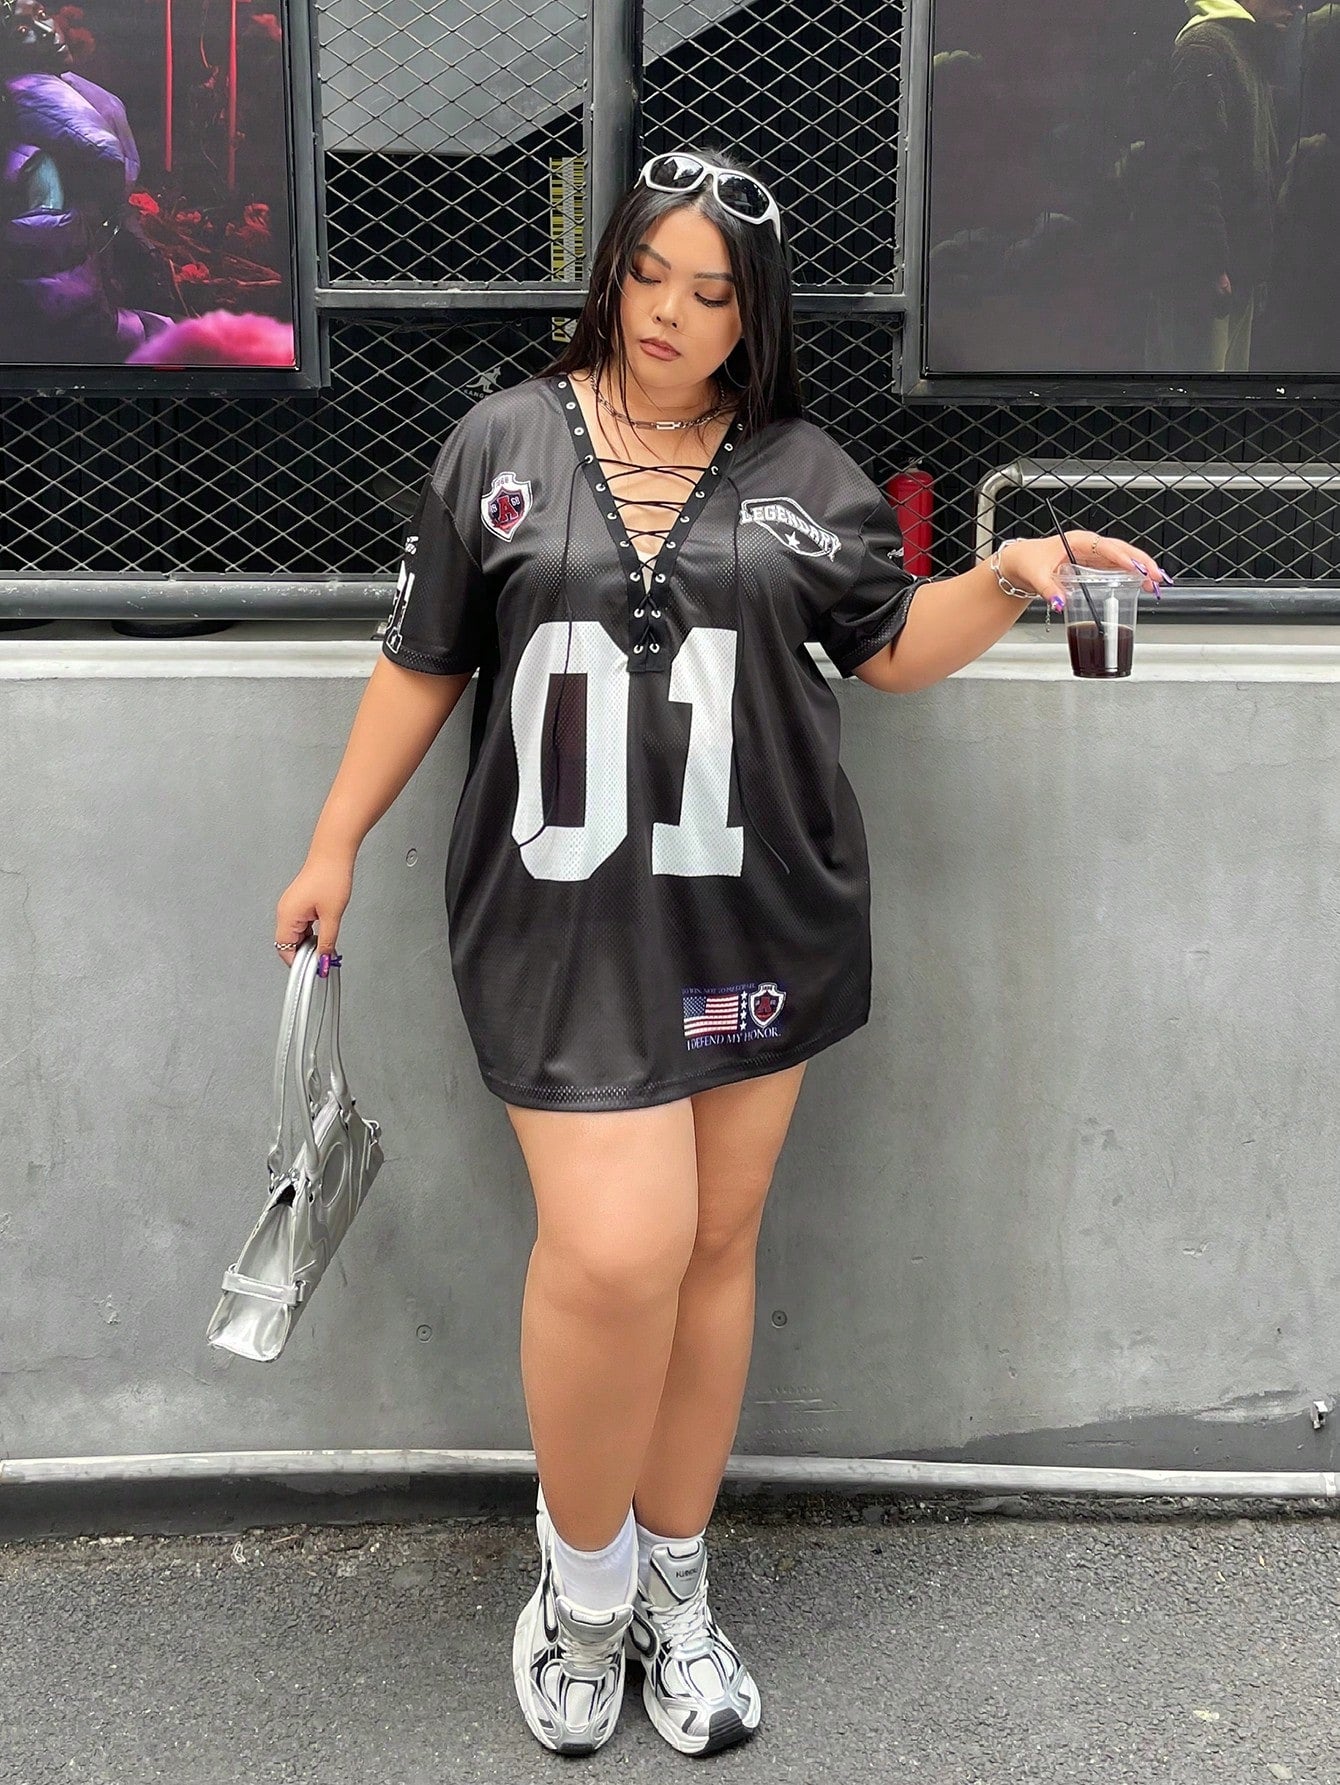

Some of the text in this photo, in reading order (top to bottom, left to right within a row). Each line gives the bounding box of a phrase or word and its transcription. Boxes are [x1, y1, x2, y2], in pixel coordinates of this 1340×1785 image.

[497, 495, 519, 523] A
[739, 504, 842, 562] LEGENDARY
[511, 621, 744, 881] 01
[687, 1040, 691, 1051] I
[691, 1035, 724, 1049] DEFEND
[727, 1033, 742, 1043] MY
